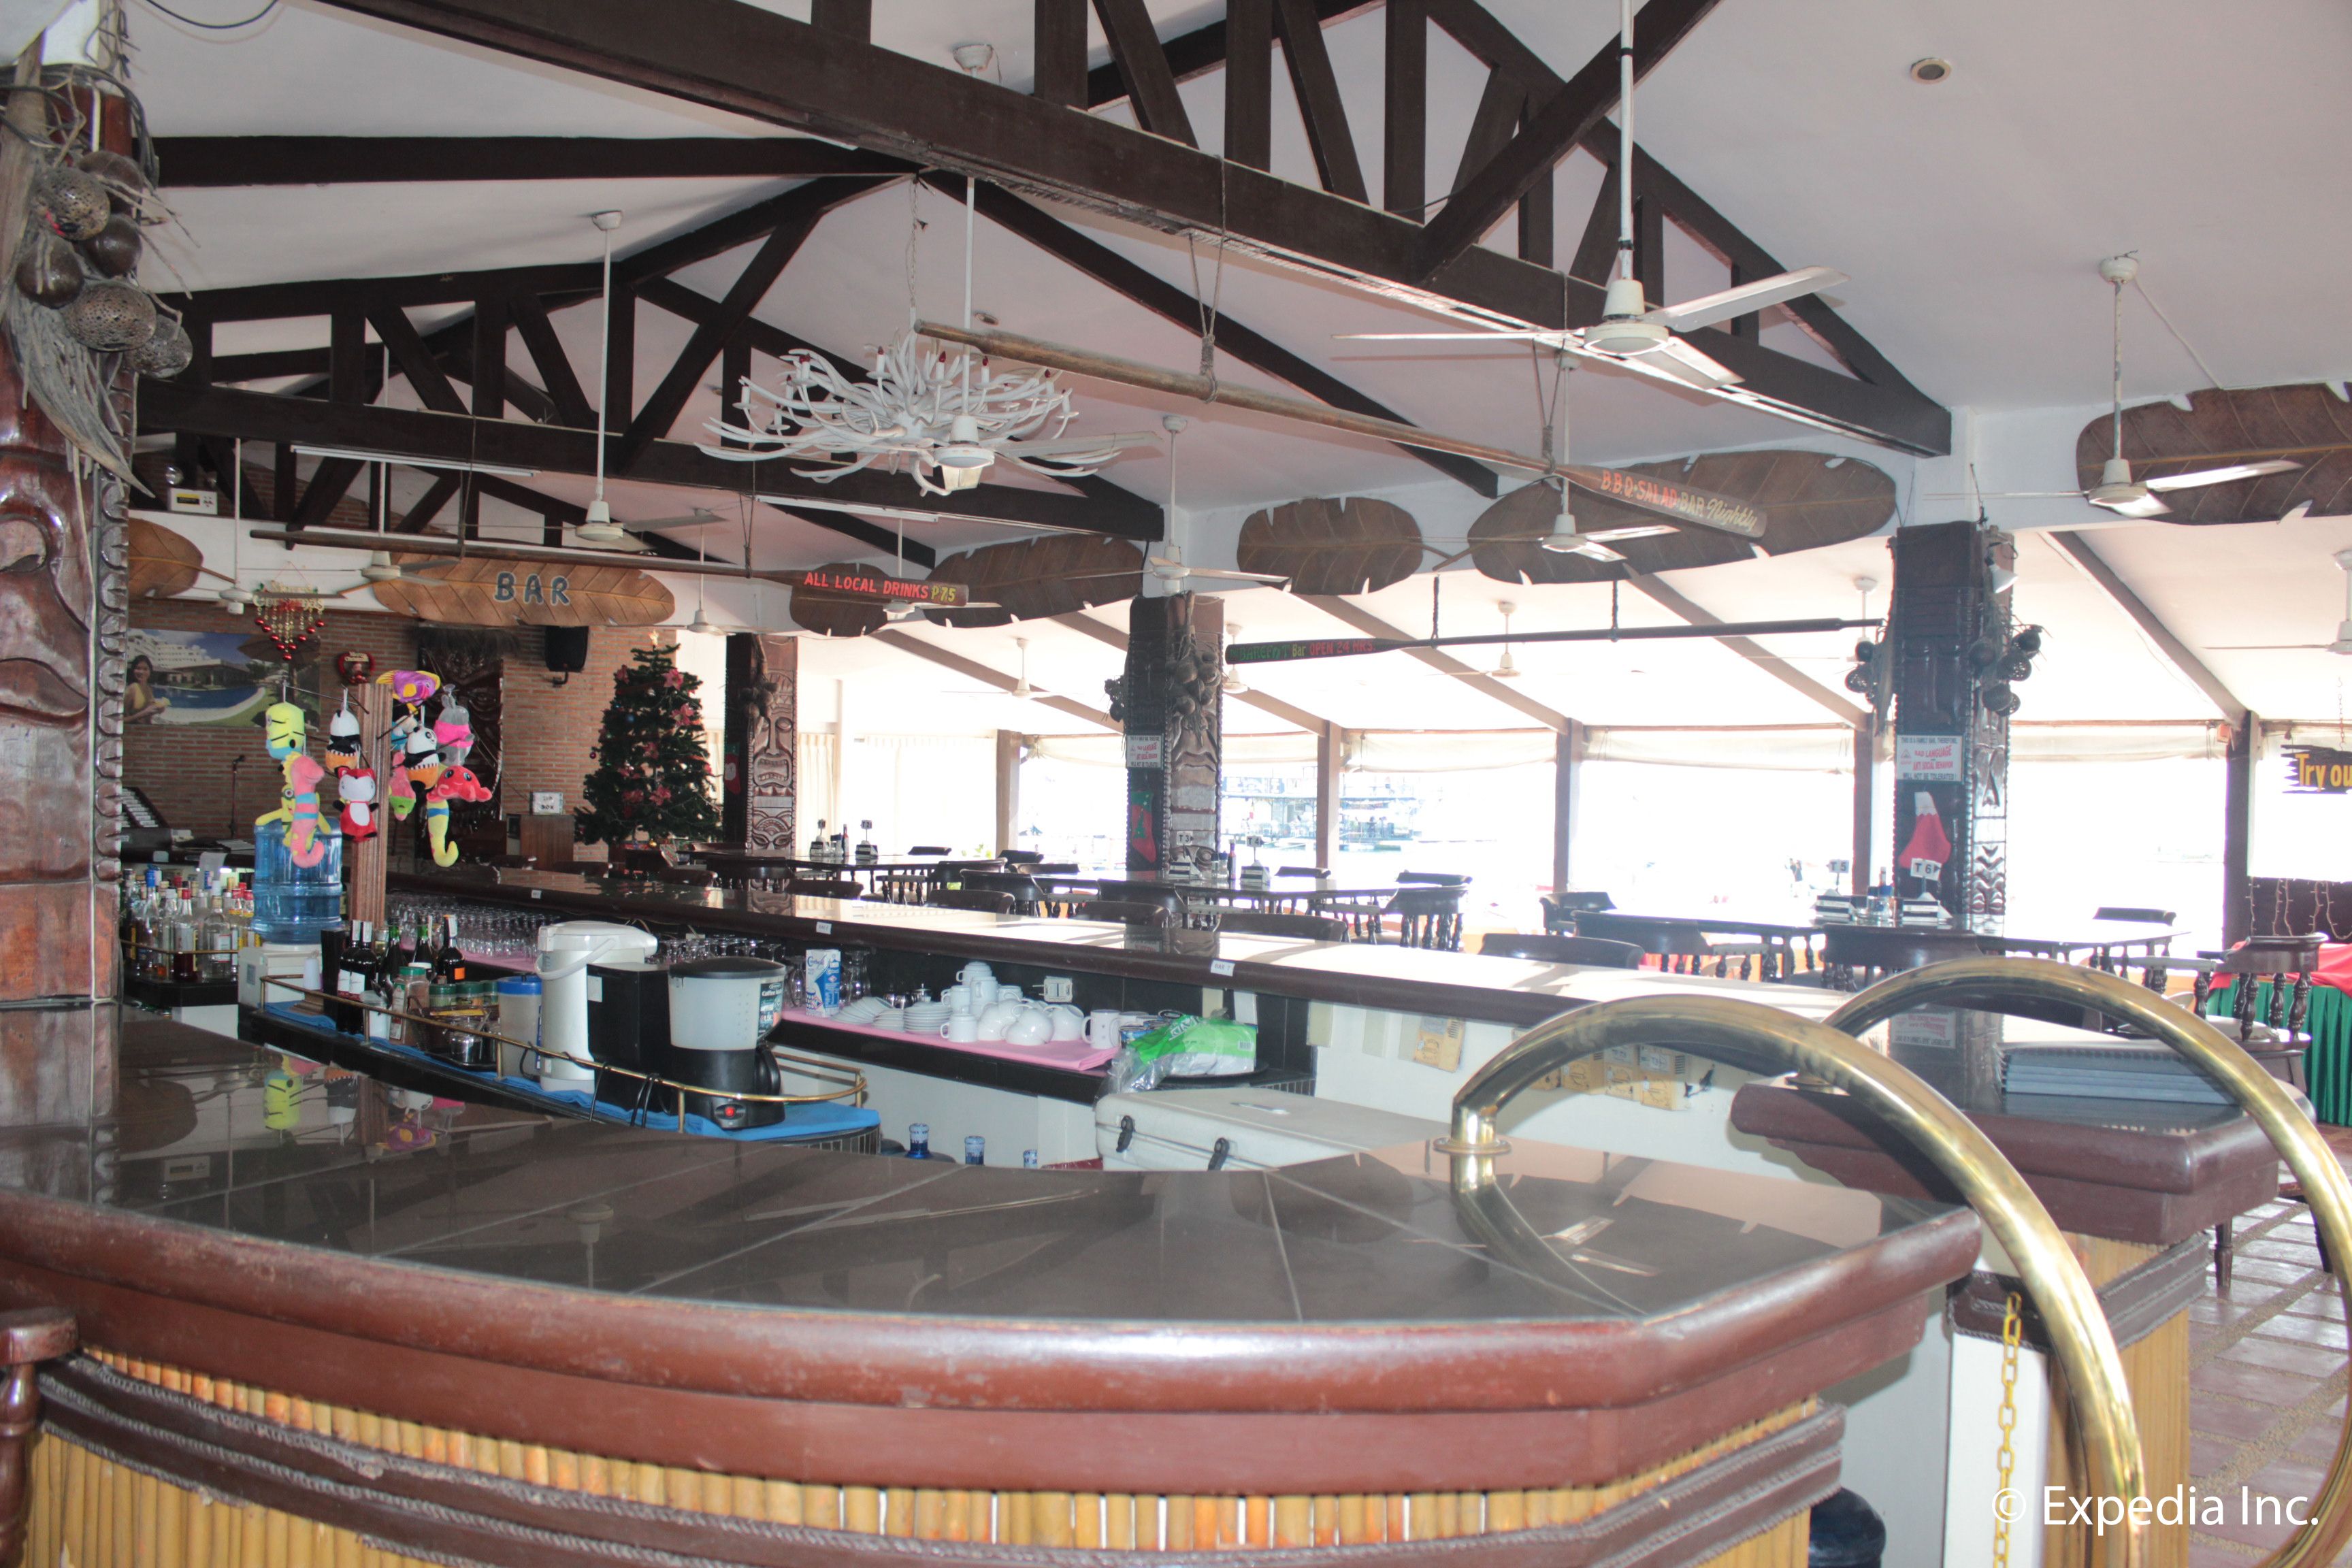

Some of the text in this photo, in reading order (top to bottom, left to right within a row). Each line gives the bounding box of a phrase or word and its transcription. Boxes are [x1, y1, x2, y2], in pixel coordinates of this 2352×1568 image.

[1636, 480, 1678, 508] SALAD
[1707, 498, 1758, 532] Nightly
[494, 571, 570, 606] BAR
[804, 572, 829, 587] ALL
[835, 575, 877, 593] LOCAL
[883, 580, 930, 600] DRINKS
[1292, 642, 1307, 657] Bar
[1309, 641, 1334, 655] OPEN
[1337, 641, 1350, 654] 24
[1925, 745, 1952, 757] LANGUAGE
[2295, 753, 2327, 793] Try
